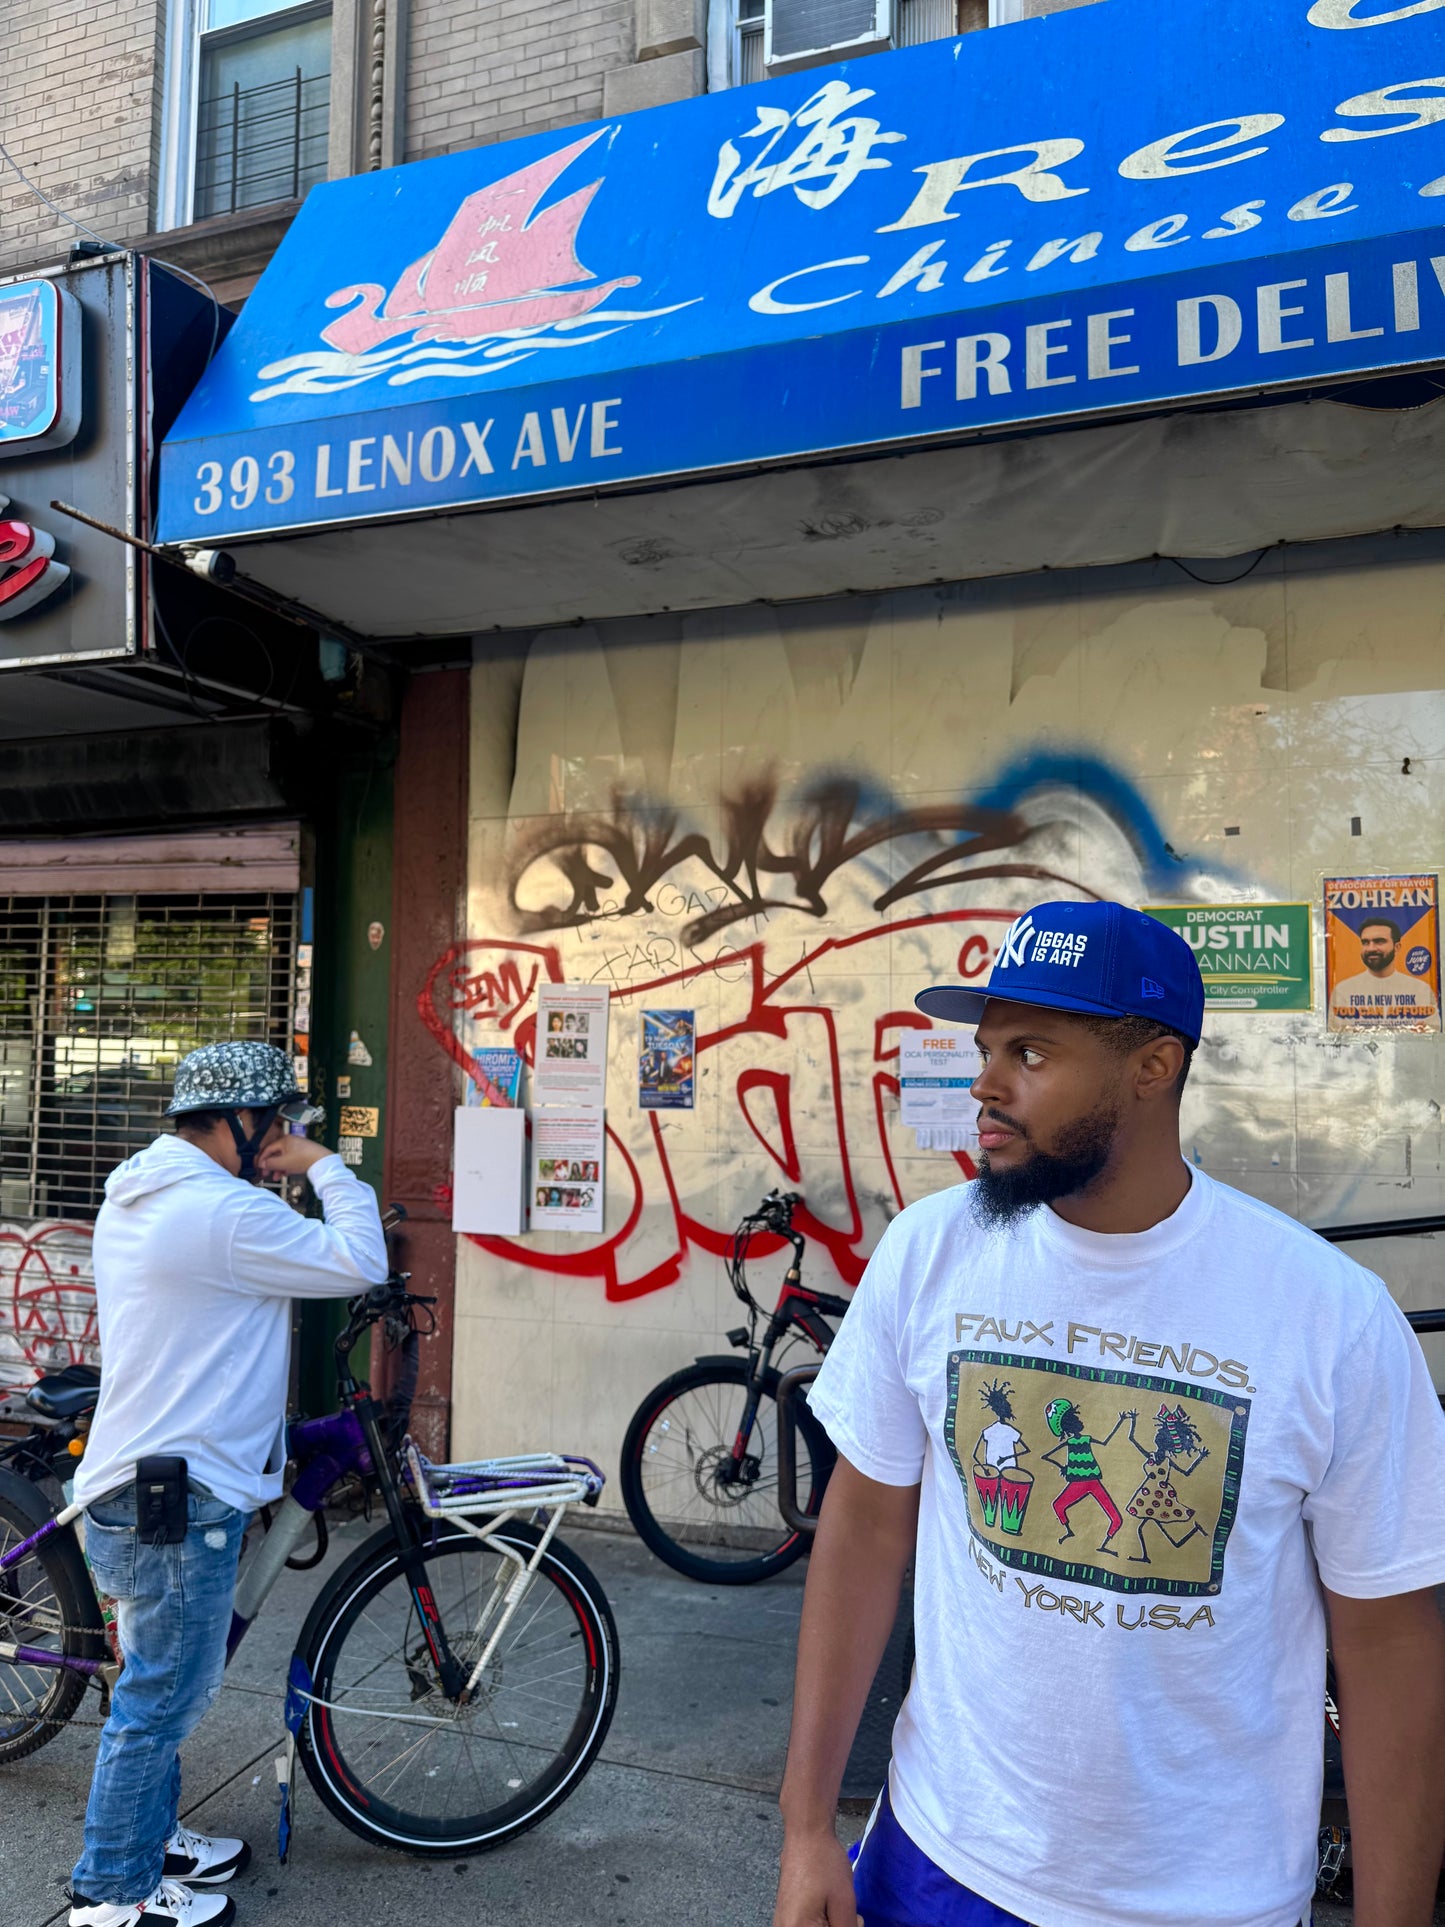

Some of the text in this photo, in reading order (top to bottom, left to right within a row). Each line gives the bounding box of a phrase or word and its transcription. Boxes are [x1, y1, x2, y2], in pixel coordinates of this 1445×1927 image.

[707, 80, 907, 218] 海
[748, 182, 1359, 315] Chinese
[900, 307, 1140, 410] FREE
[193, 398, 623, 515] 393 LENOX AVE
[1328, 877, 1432, 890] DEMOCRAT FOR MAYOR
[1327, 887, 1434, 910] ZOHRAN
[1186, 910, 1264, 923] DEMOCRAT
[1035, 930, 1088, 952] IGGAS
[1172, 923, 1290, 951] USTIN
[1031, 947, 1084, 968] IS ART
[1197, 952, 1290, 971] ANNAN
[1406, 954, 1430, 965] JUNE
[1411, 963, 1425, 973] 24
[1209, 985, 1289, 996] City Comptroller
[1350, 994, 1416, 1006] FOR A NEW YORK
[1333, 1006, 1436, 1018] YOU CAN AFFORD
[922, 1038, 957, 1049] FREE
[923, 1050, 975, 1059] PERSONALITY
[955, 1312, 1055, 1347] FAUX
[968, 1535, 1216, 1631] NEW YORK U.S.A
